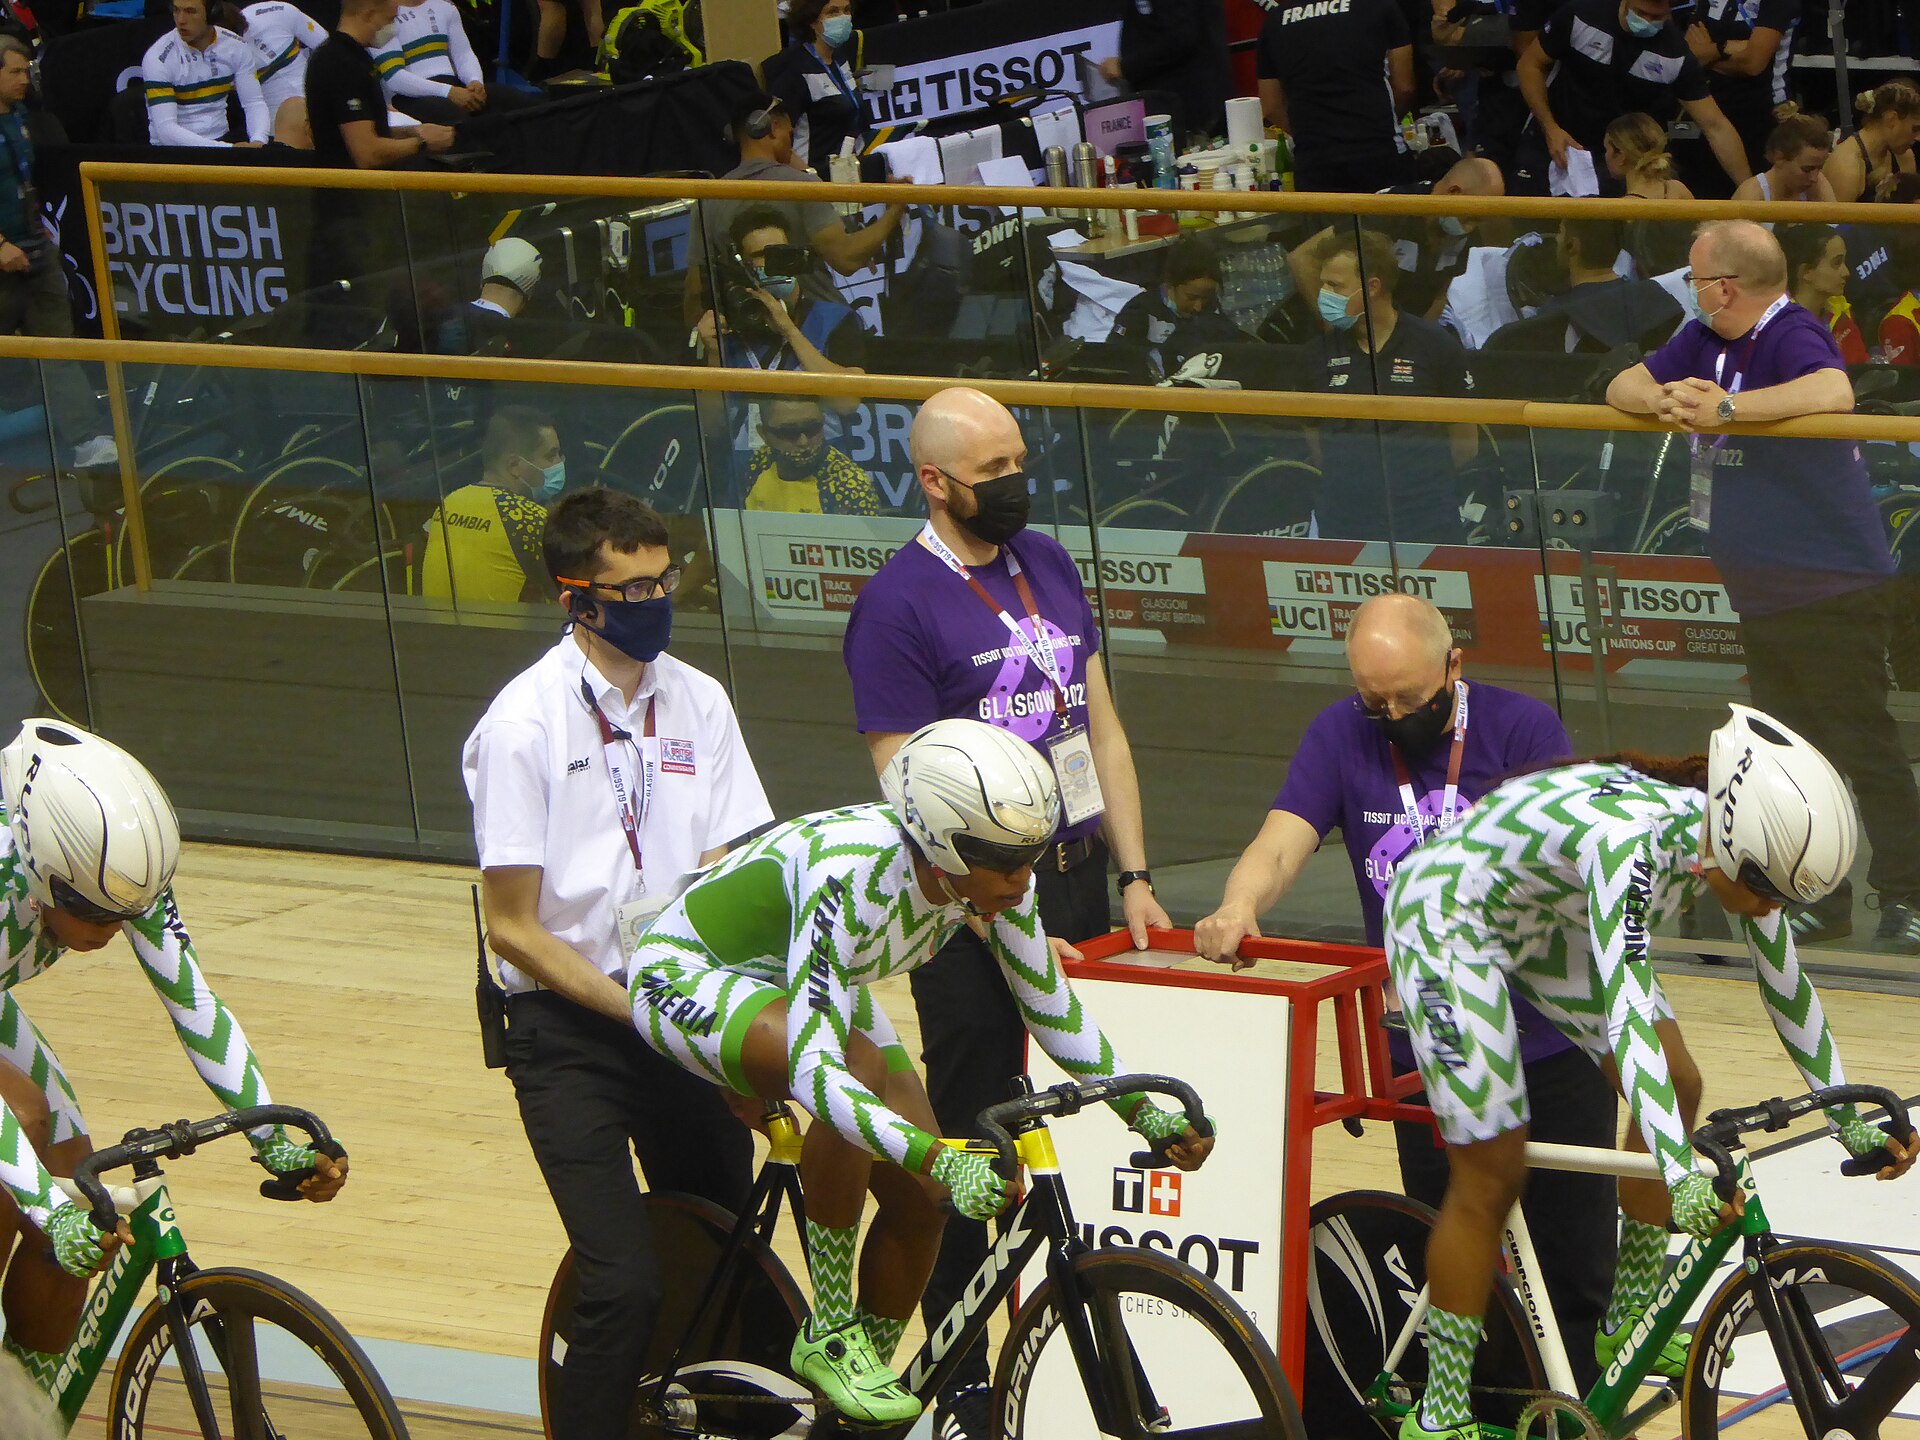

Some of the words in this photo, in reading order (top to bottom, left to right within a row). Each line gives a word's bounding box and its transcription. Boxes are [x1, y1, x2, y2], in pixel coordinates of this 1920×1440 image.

[1282, 0, 1351, 25] FRANCE
[925, 41, 1091, 112] TISSOT
[1101, 115, 1133, 134] FRANCE
[101, 202, 283, 260] BRITISH
[1075, 558, 1172, 585] TSSOT
[775, 577, 818, 601] UCI
[824, 580, 852, 591] TRACK
[1334, 571, 1437, 599] TISSOT
[826, 593, 859, 605] NATION
[1141, 598, 1188, 610] GLASGOW
[1142, 611, 1171, 622] GREAT
[1173, 612, 1205, 625] BRITAIN
[1279, 605, 1326, 631] UCI
[1333, 608, 1355, 619] TRAC
[1556, 620, 1593, 646] UC
[1619, 625, 1640, 636] ACK
[1685, 628, 1737, 641] GLASGOW
[972, 647, 1001, 667] TISSOT
[1610, 638, 1654, 651] NATIONS
[1656, 640, 1677, 651] CUP
[1687, 641, 1718, 653] GREAT
[1720, 643, 1745, 656] BRITA
[979, 688, 1055, 720] GLASGOW
[1062, 683, 1087, 709] 202
[611, 766, 627, 803] GLASGOW
[646, 761, 655, 798] GLASGOW
[1721, 747, 1754, 862] RUDY
[1624, 858, 1653, 965] NIGERIA
[809, 874, 847, 1016] NIGERIA
[910, 1200, 1032, 1393] LOOK
[1118, 1296, 1164, 1316] CHES
[1703, 1267, 1829, 1389] CORMA
[1003, 1304, 1060, 1440] ORIM
